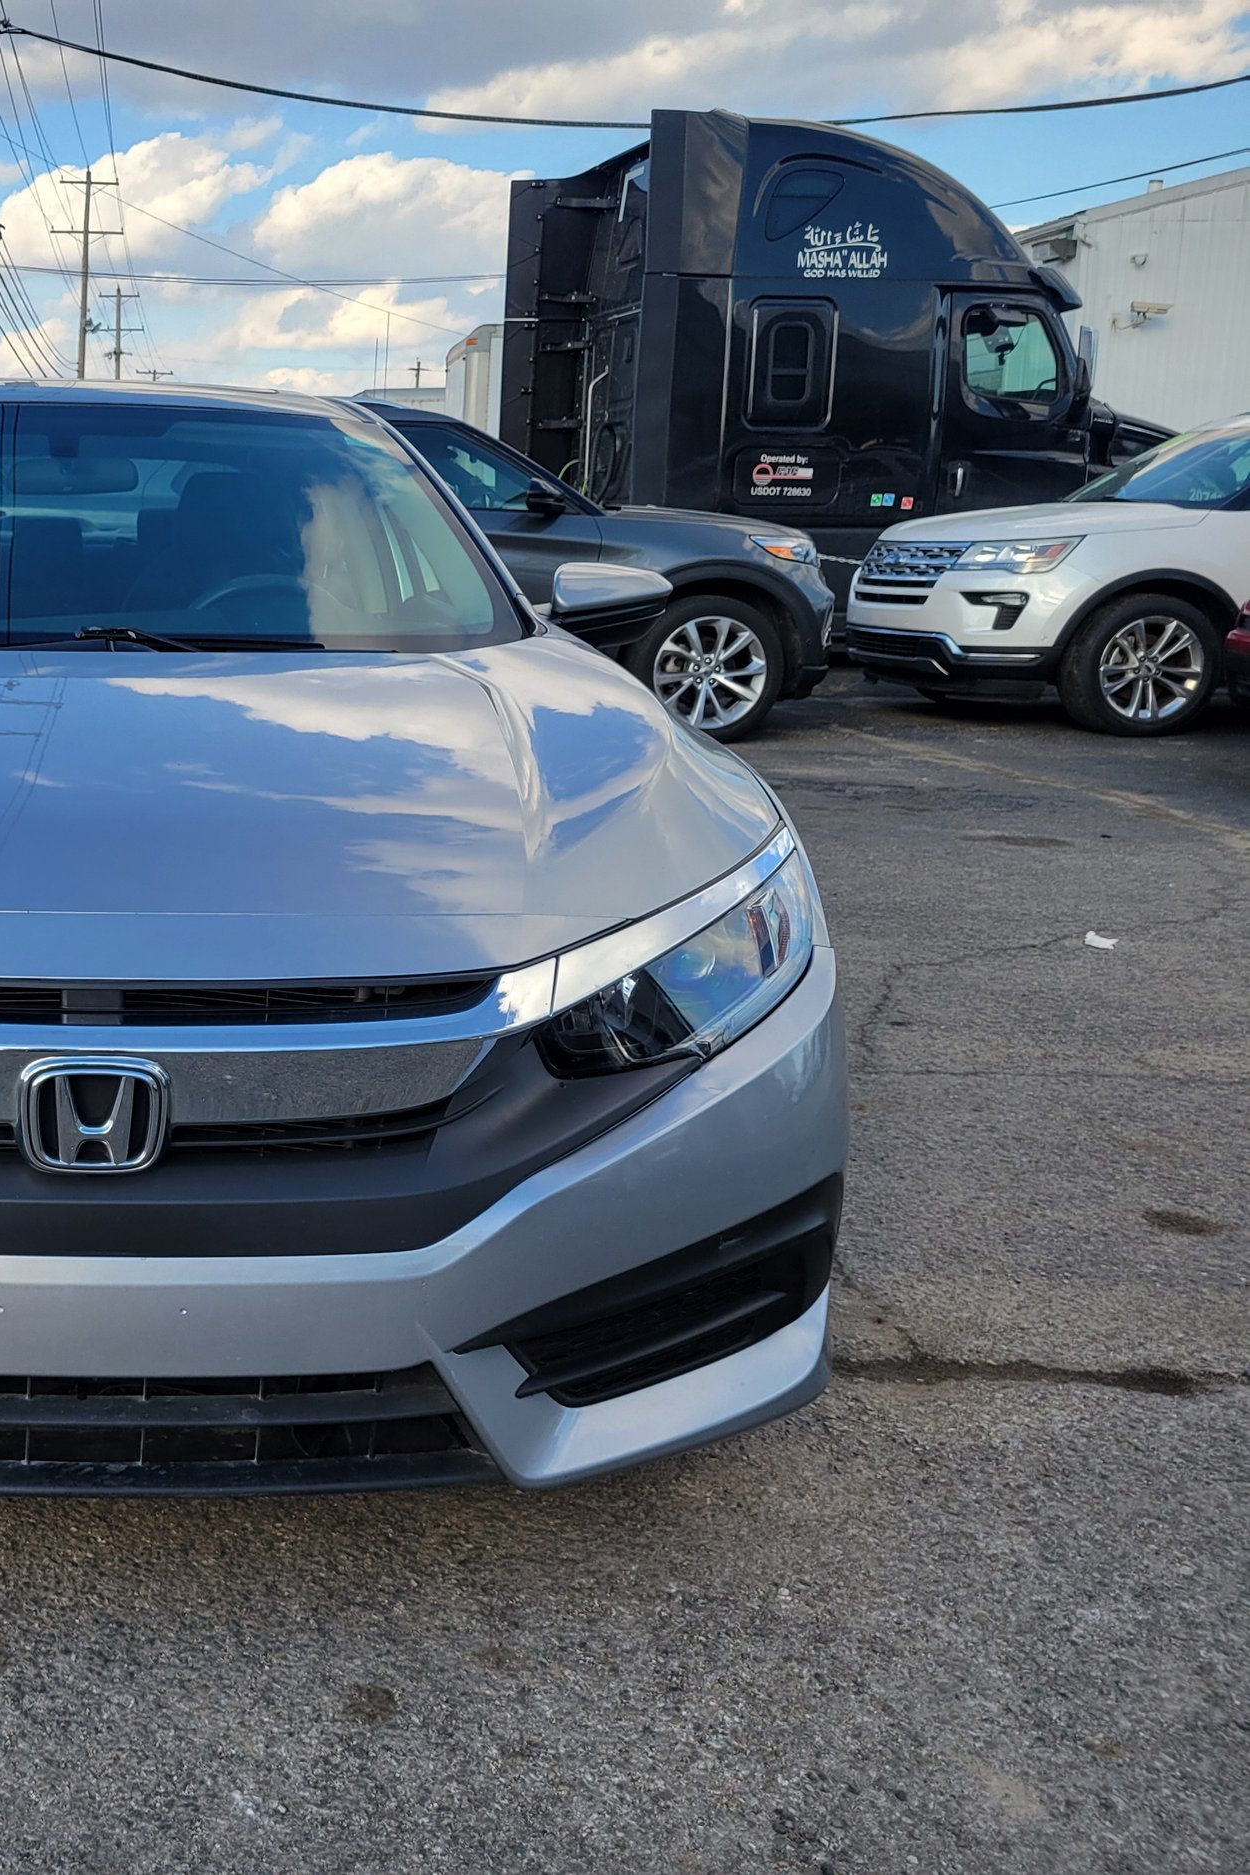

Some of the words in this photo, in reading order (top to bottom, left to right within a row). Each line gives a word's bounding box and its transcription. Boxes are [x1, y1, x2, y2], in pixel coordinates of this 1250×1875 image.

[803, 269, 825, 278] GOD
[827, 269, 846, 278] HAS
[848, 269, 880, 278] WILLED
[760, 453, 796, 464] Operated
[796, 454, 809, 465] by:
[750, 486, 782, 496] USDOT
